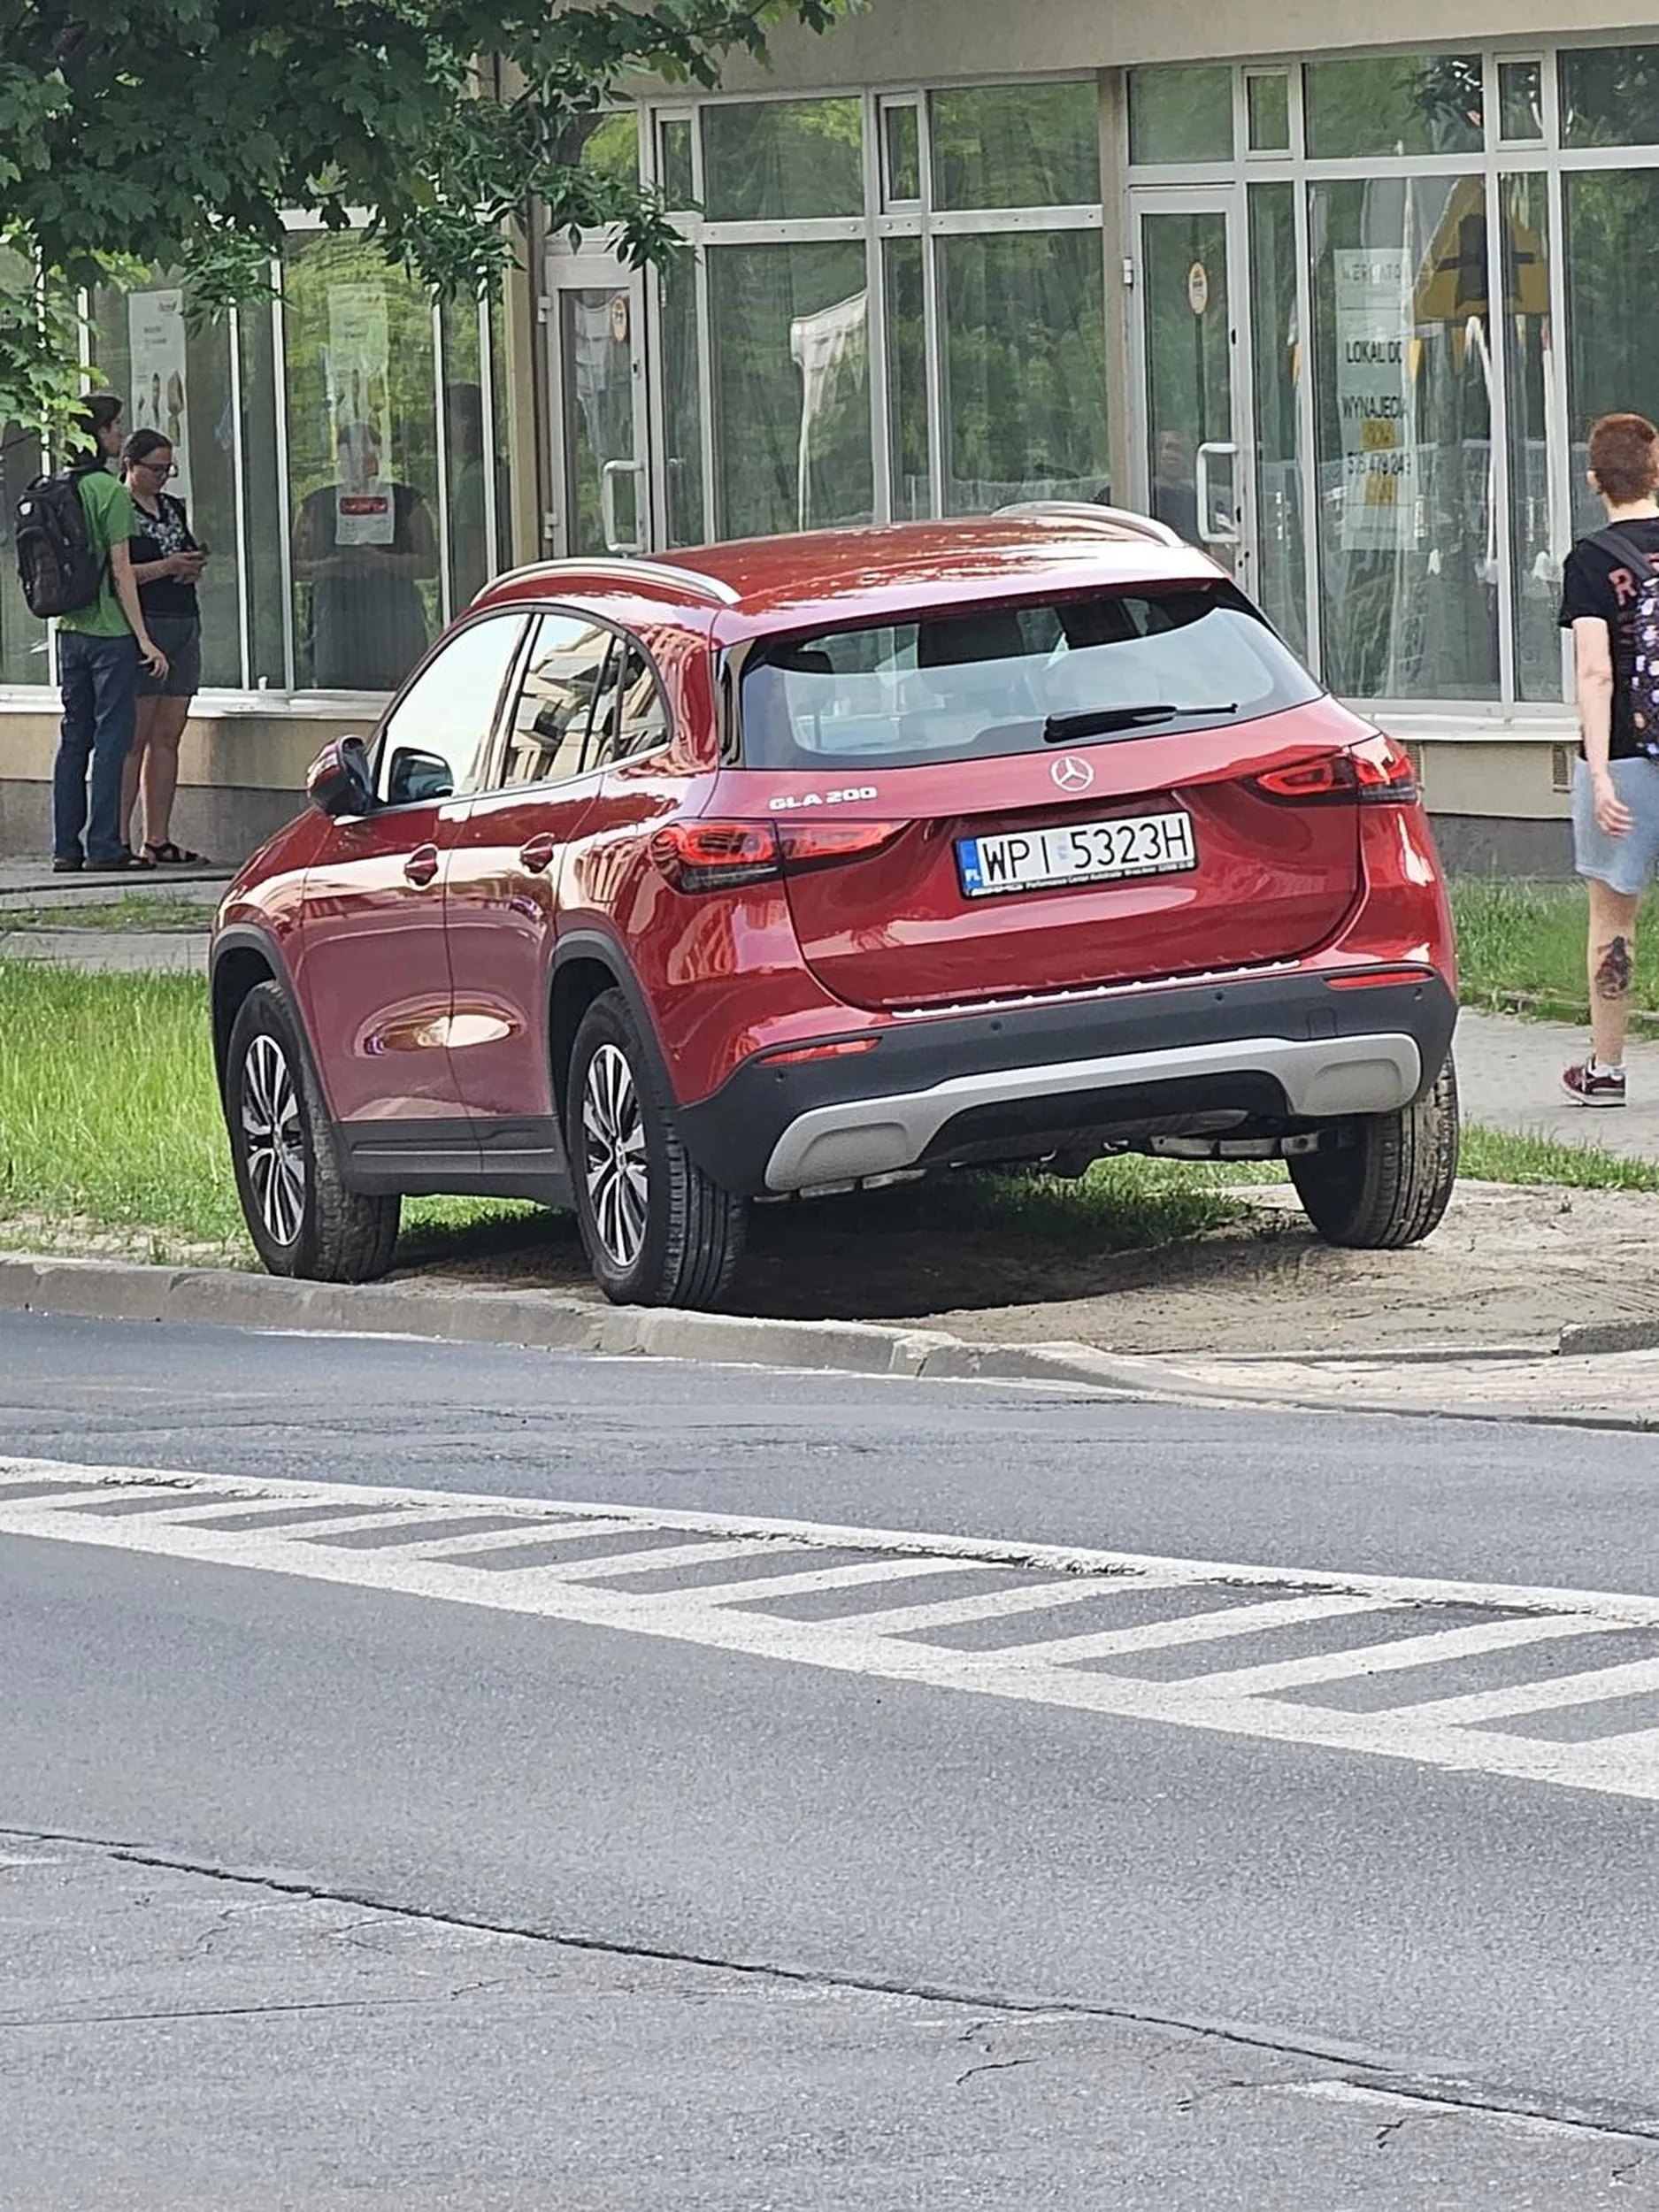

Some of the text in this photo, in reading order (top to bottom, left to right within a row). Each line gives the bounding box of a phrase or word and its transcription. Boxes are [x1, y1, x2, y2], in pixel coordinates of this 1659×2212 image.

[768, 786, 878, 811] GLA 200
[983, 835, 1050, 882] WPI
[1070, 818, 1188, 869] 5323H
